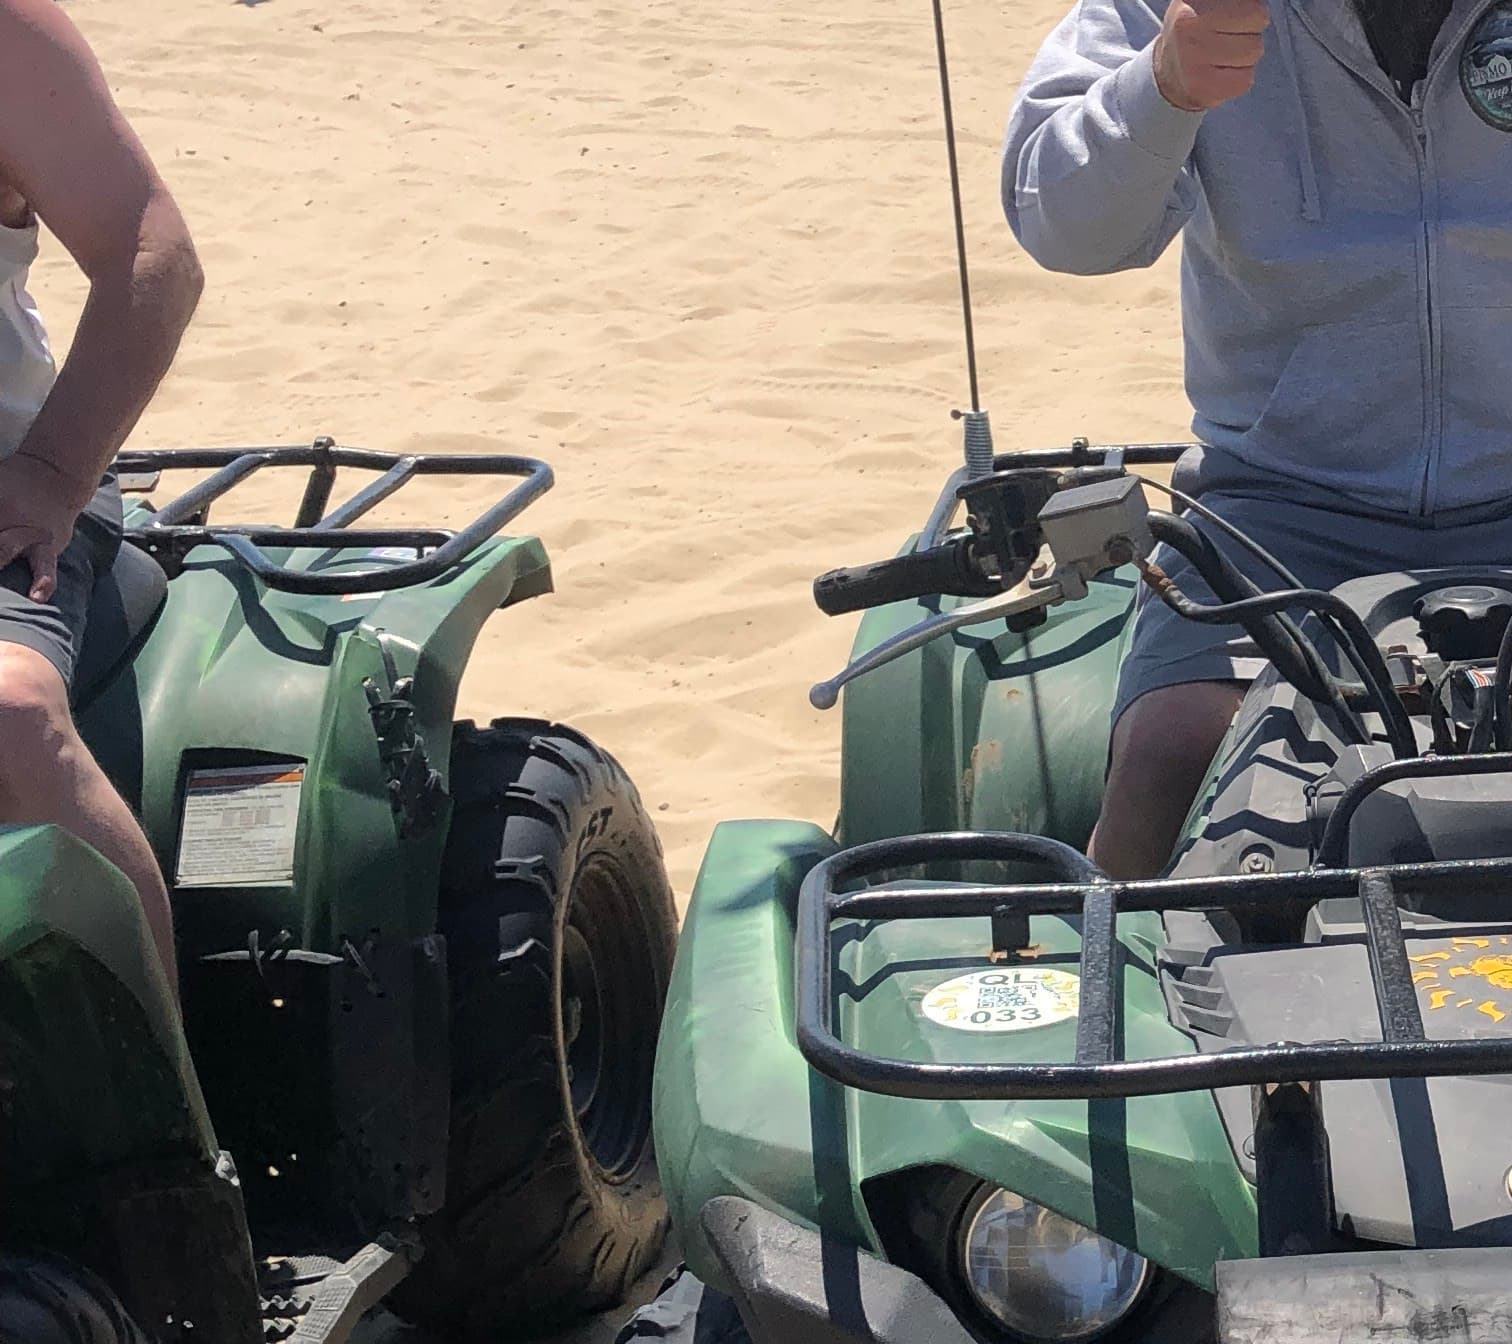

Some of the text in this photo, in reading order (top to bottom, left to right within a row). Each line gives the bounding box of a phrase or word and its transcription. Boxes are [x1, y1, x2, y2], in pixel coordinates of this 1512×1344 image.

[1486, 86, 1509, 101] Keep
[978, 973, 1038, 985] QL
[970, 1008, 1042, 1023] 033
